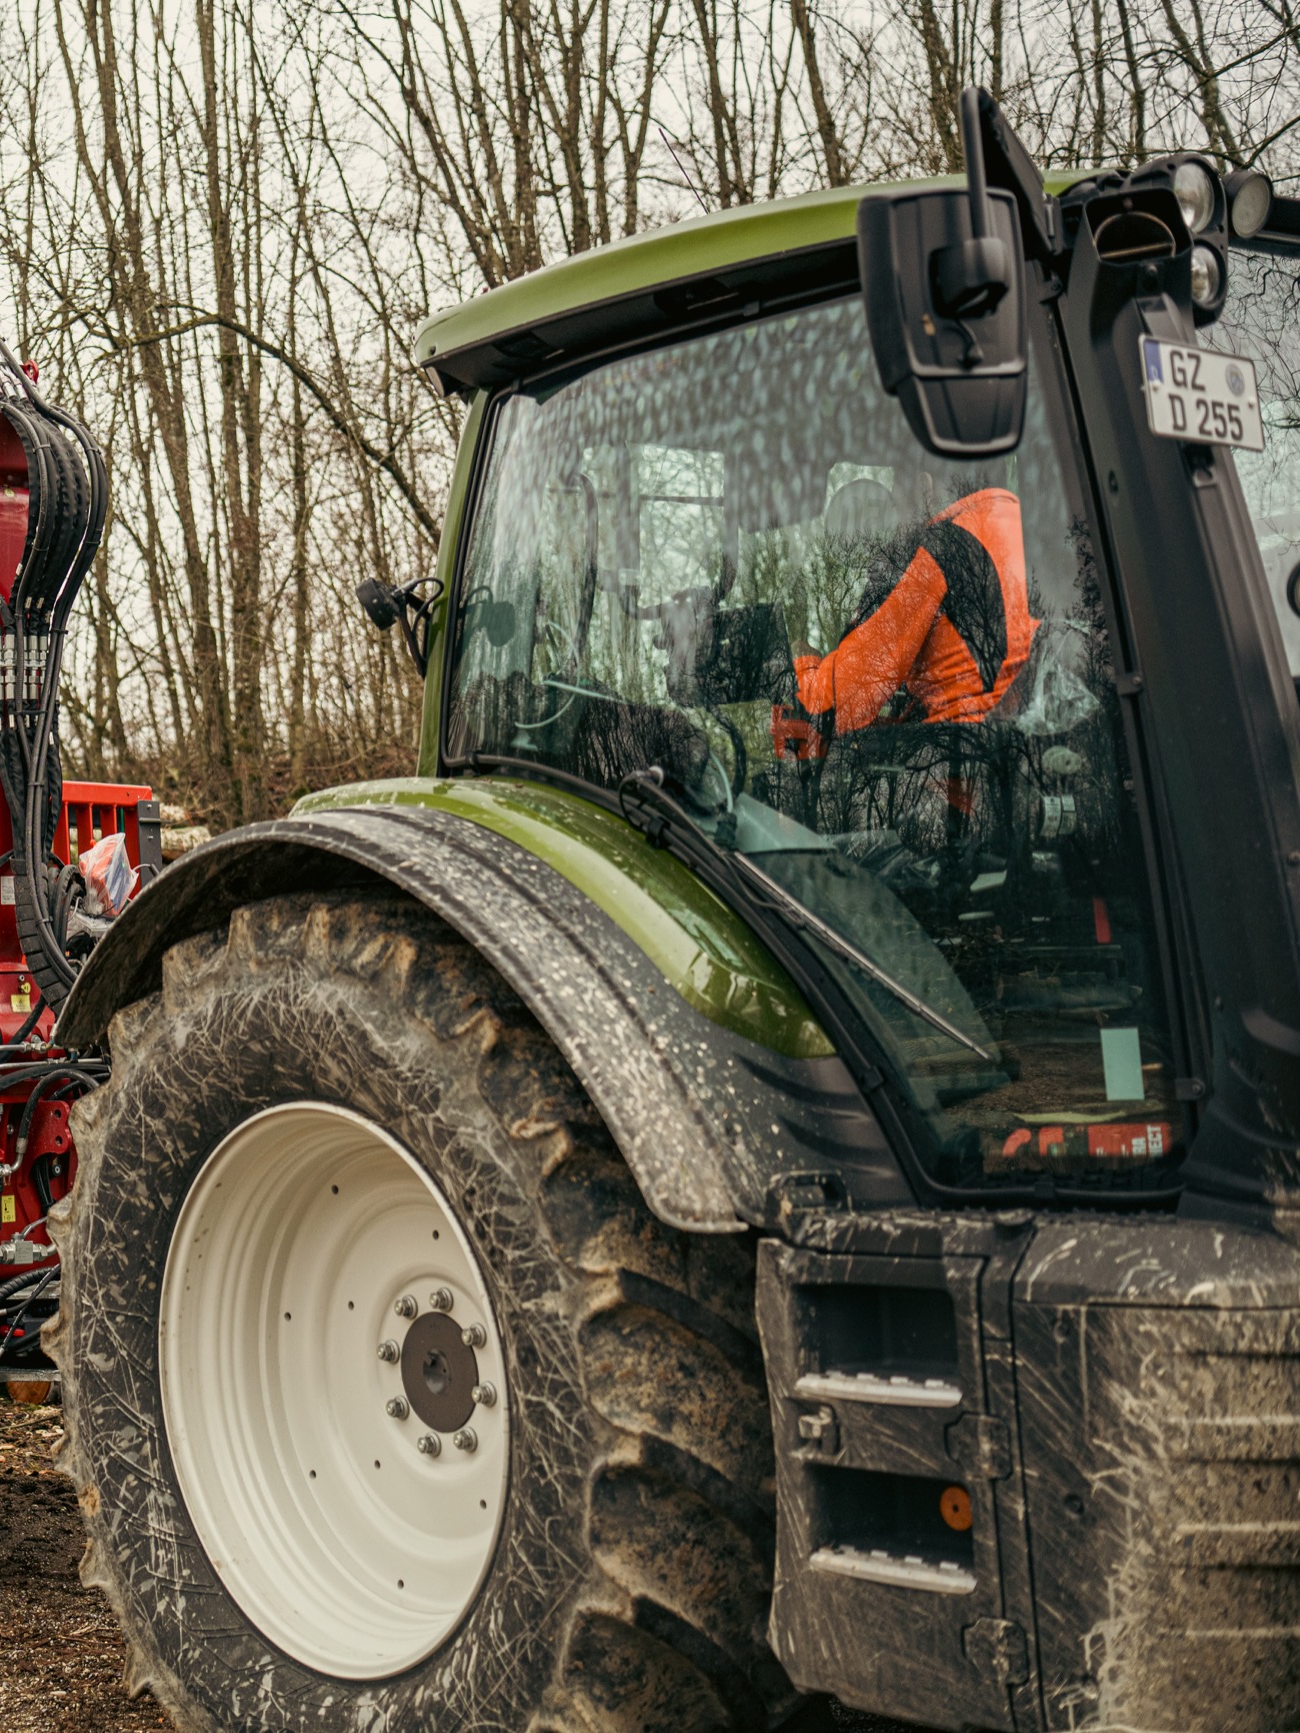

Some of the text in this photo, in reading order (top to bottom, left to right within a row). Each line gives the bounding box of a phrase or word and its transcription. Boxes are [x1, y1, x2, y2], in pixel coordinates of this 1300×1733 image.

[1170, 350, 1206, 392] GZ
[1168, 393, 1243, 441] D 255
